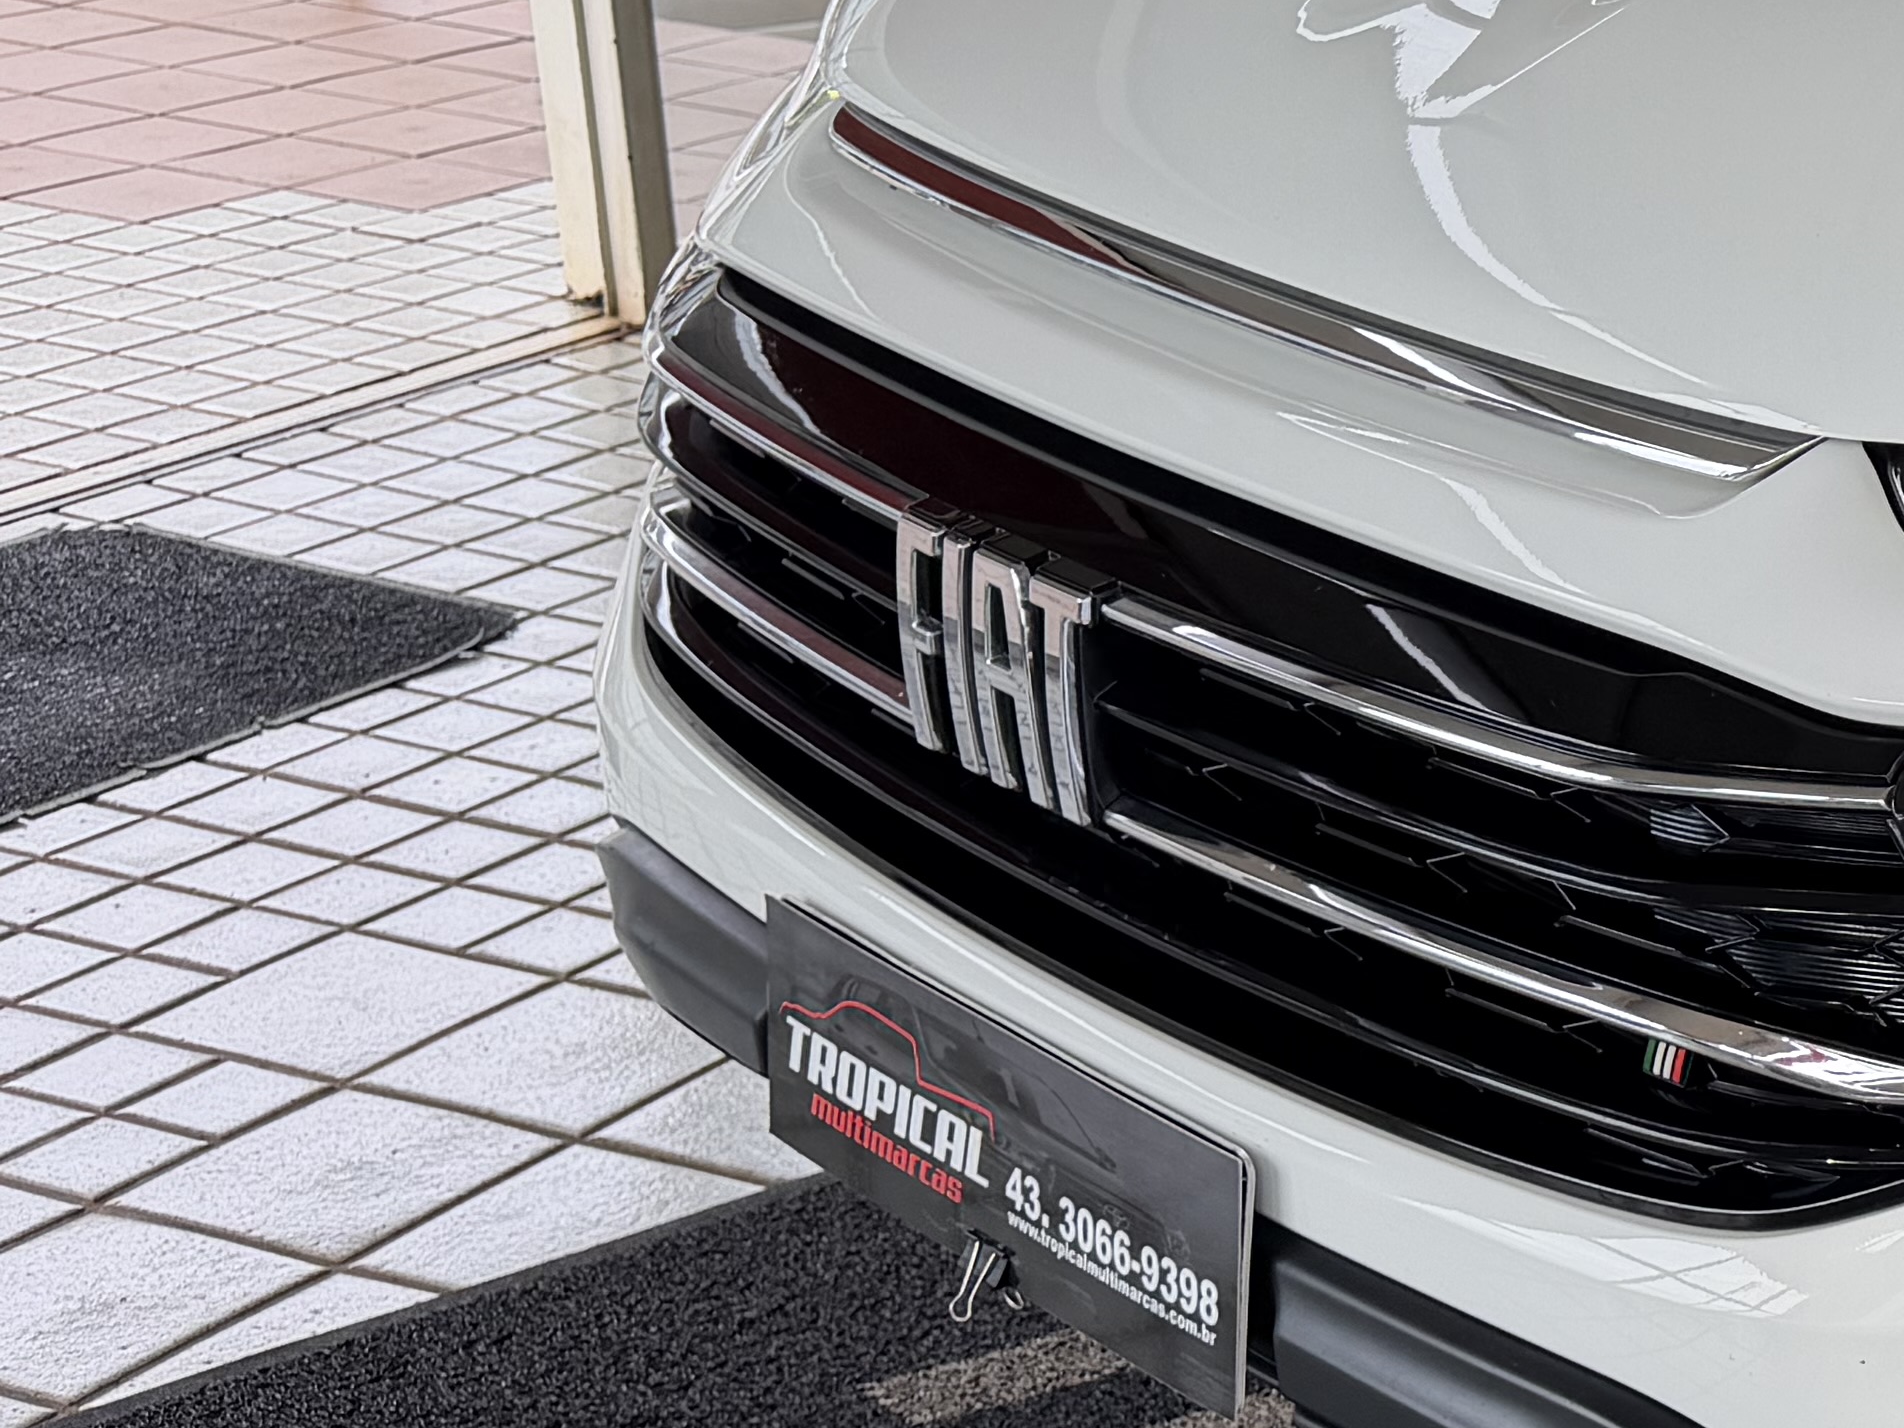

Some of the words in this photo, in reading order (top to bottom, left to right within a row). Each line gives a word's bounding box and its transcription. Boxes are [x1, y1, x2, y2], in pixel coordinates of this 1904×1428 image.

[896, 515, 1094, 828] FIAT
[786, 1015, 990, 1189] TROPICAL
[811, 1092, 964, 1205] multimarcas
[1004, 1166, 1051, 1229] 43.
[1058, 1195, 1219, 1327] 3066-9398
[1006, 1211, 1218, 1346] www.tropicalmultimarcas.com.br
